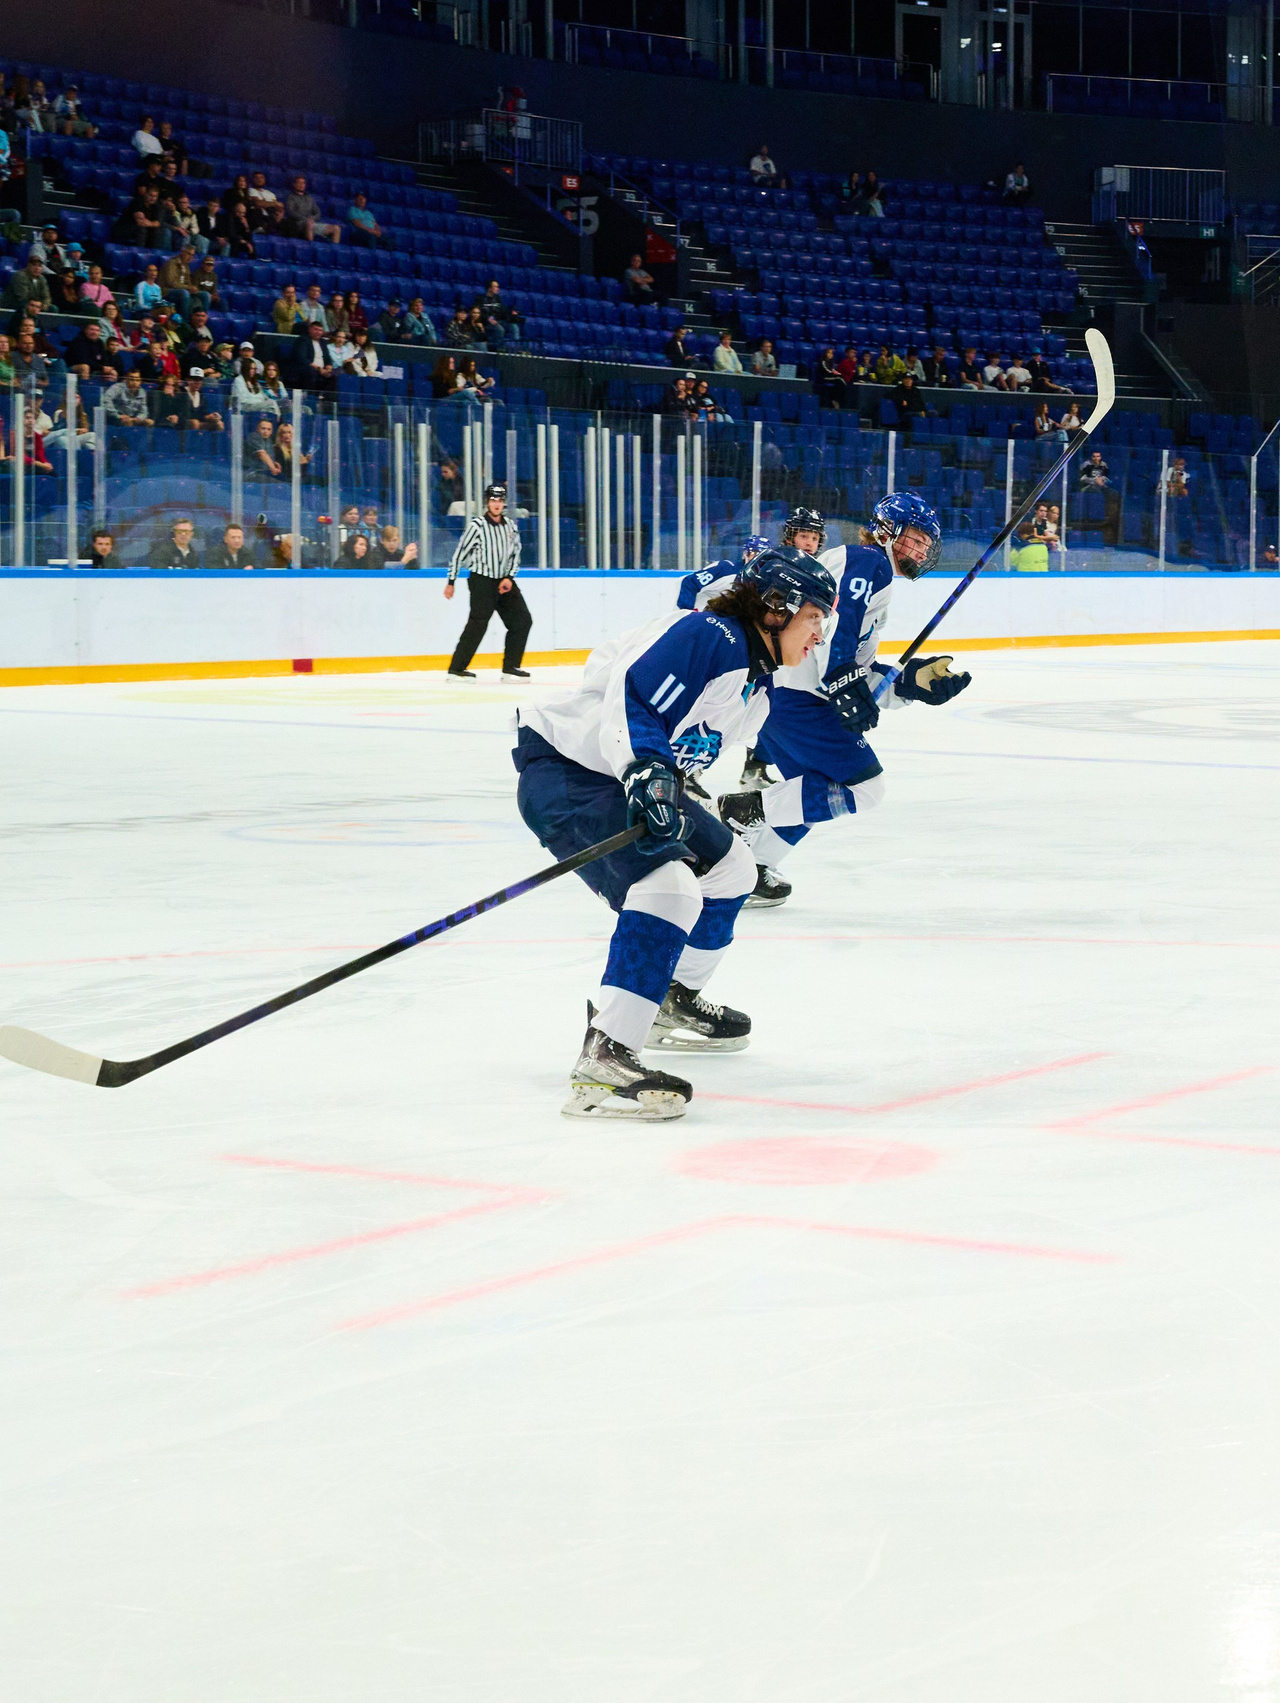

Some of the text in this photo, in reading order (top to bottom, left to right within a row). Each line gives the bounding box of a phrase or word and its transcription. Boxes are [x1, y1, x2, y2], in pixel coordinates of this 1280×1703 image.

[566, 178, 578, 187] E5
[1203, 228, 1215, 237] H1
[706, 262, 717, 271] 16
[1078, 287, 1089, 296] 16
[778, 572, 802, 587] CCM
[829, 667, 868, 694] BAUE
[649, 673, 686, 713] 11
